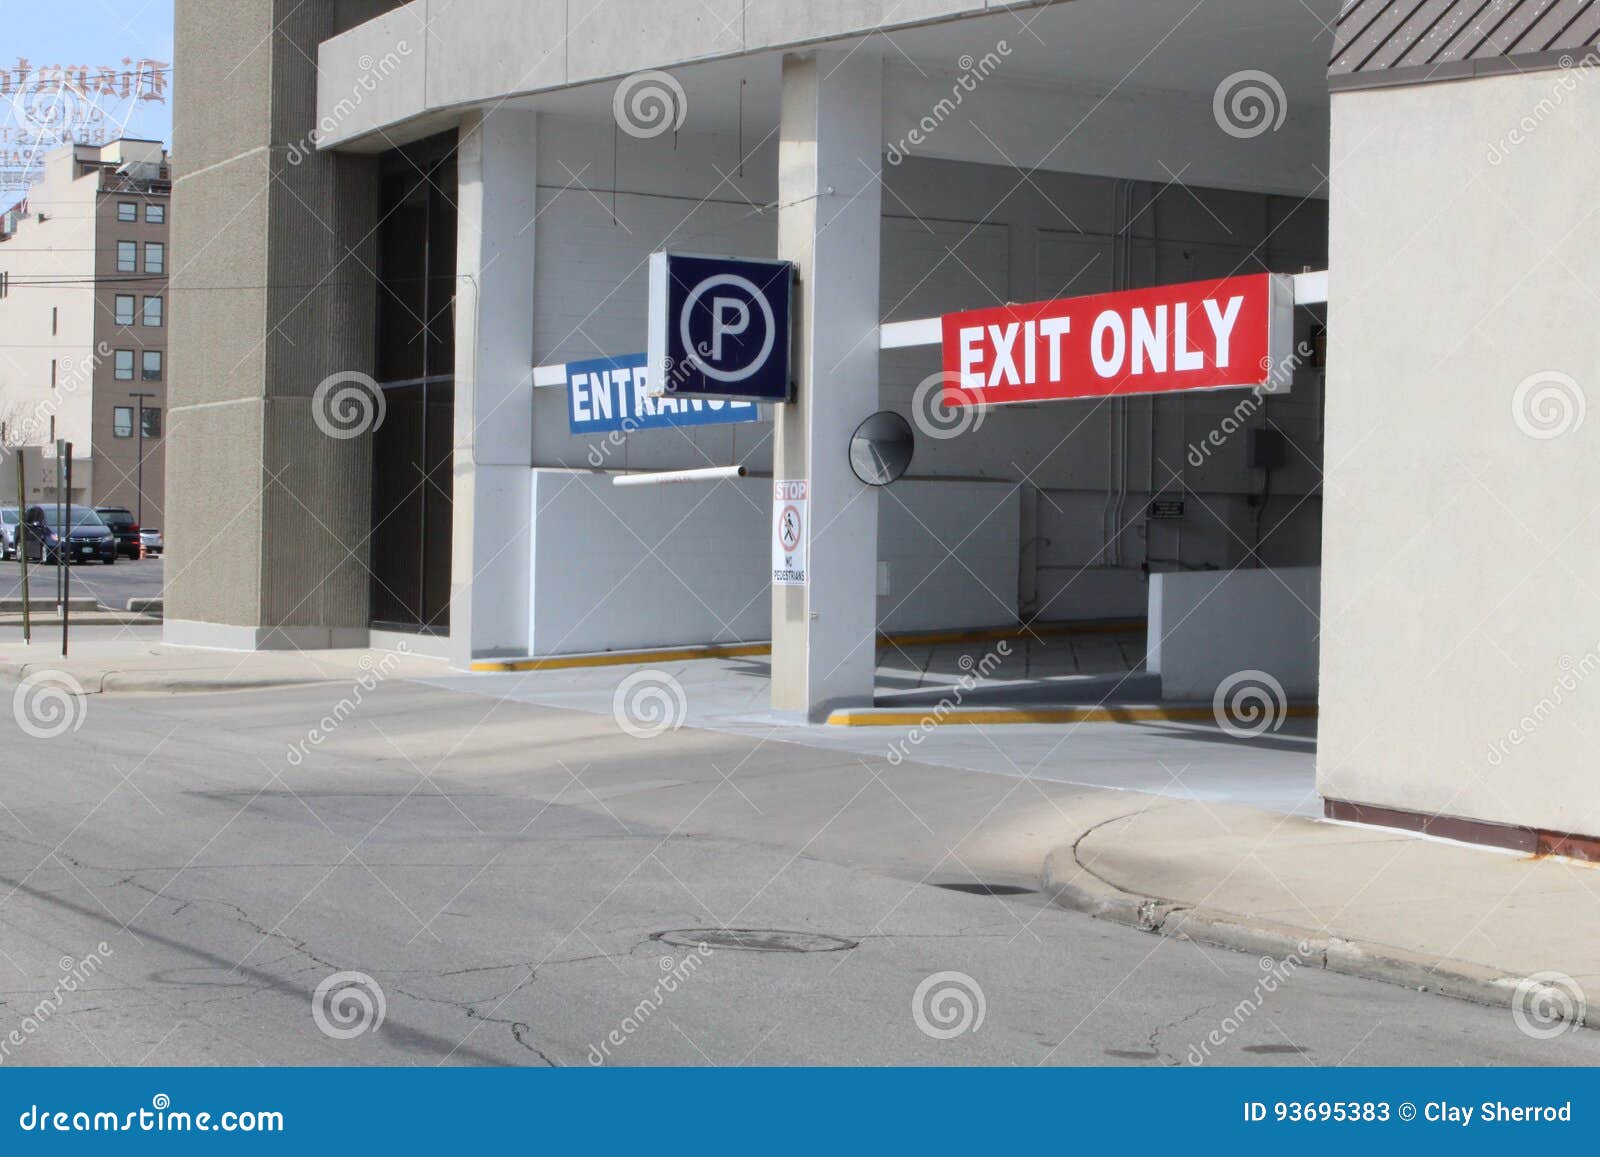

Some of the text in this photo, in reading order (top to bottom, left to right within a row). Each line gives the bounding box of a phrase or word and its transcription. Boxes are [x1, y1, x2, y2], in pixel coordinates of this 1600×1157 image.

[711, 296, 750, 361] P
[959, 295, 1245, 389] EXIT ONLY
[571, 366, 751, 422] ENTR
[776, 482, 806, 499] STOP
[774, 570, 805, 581] PEDESTRIANS
